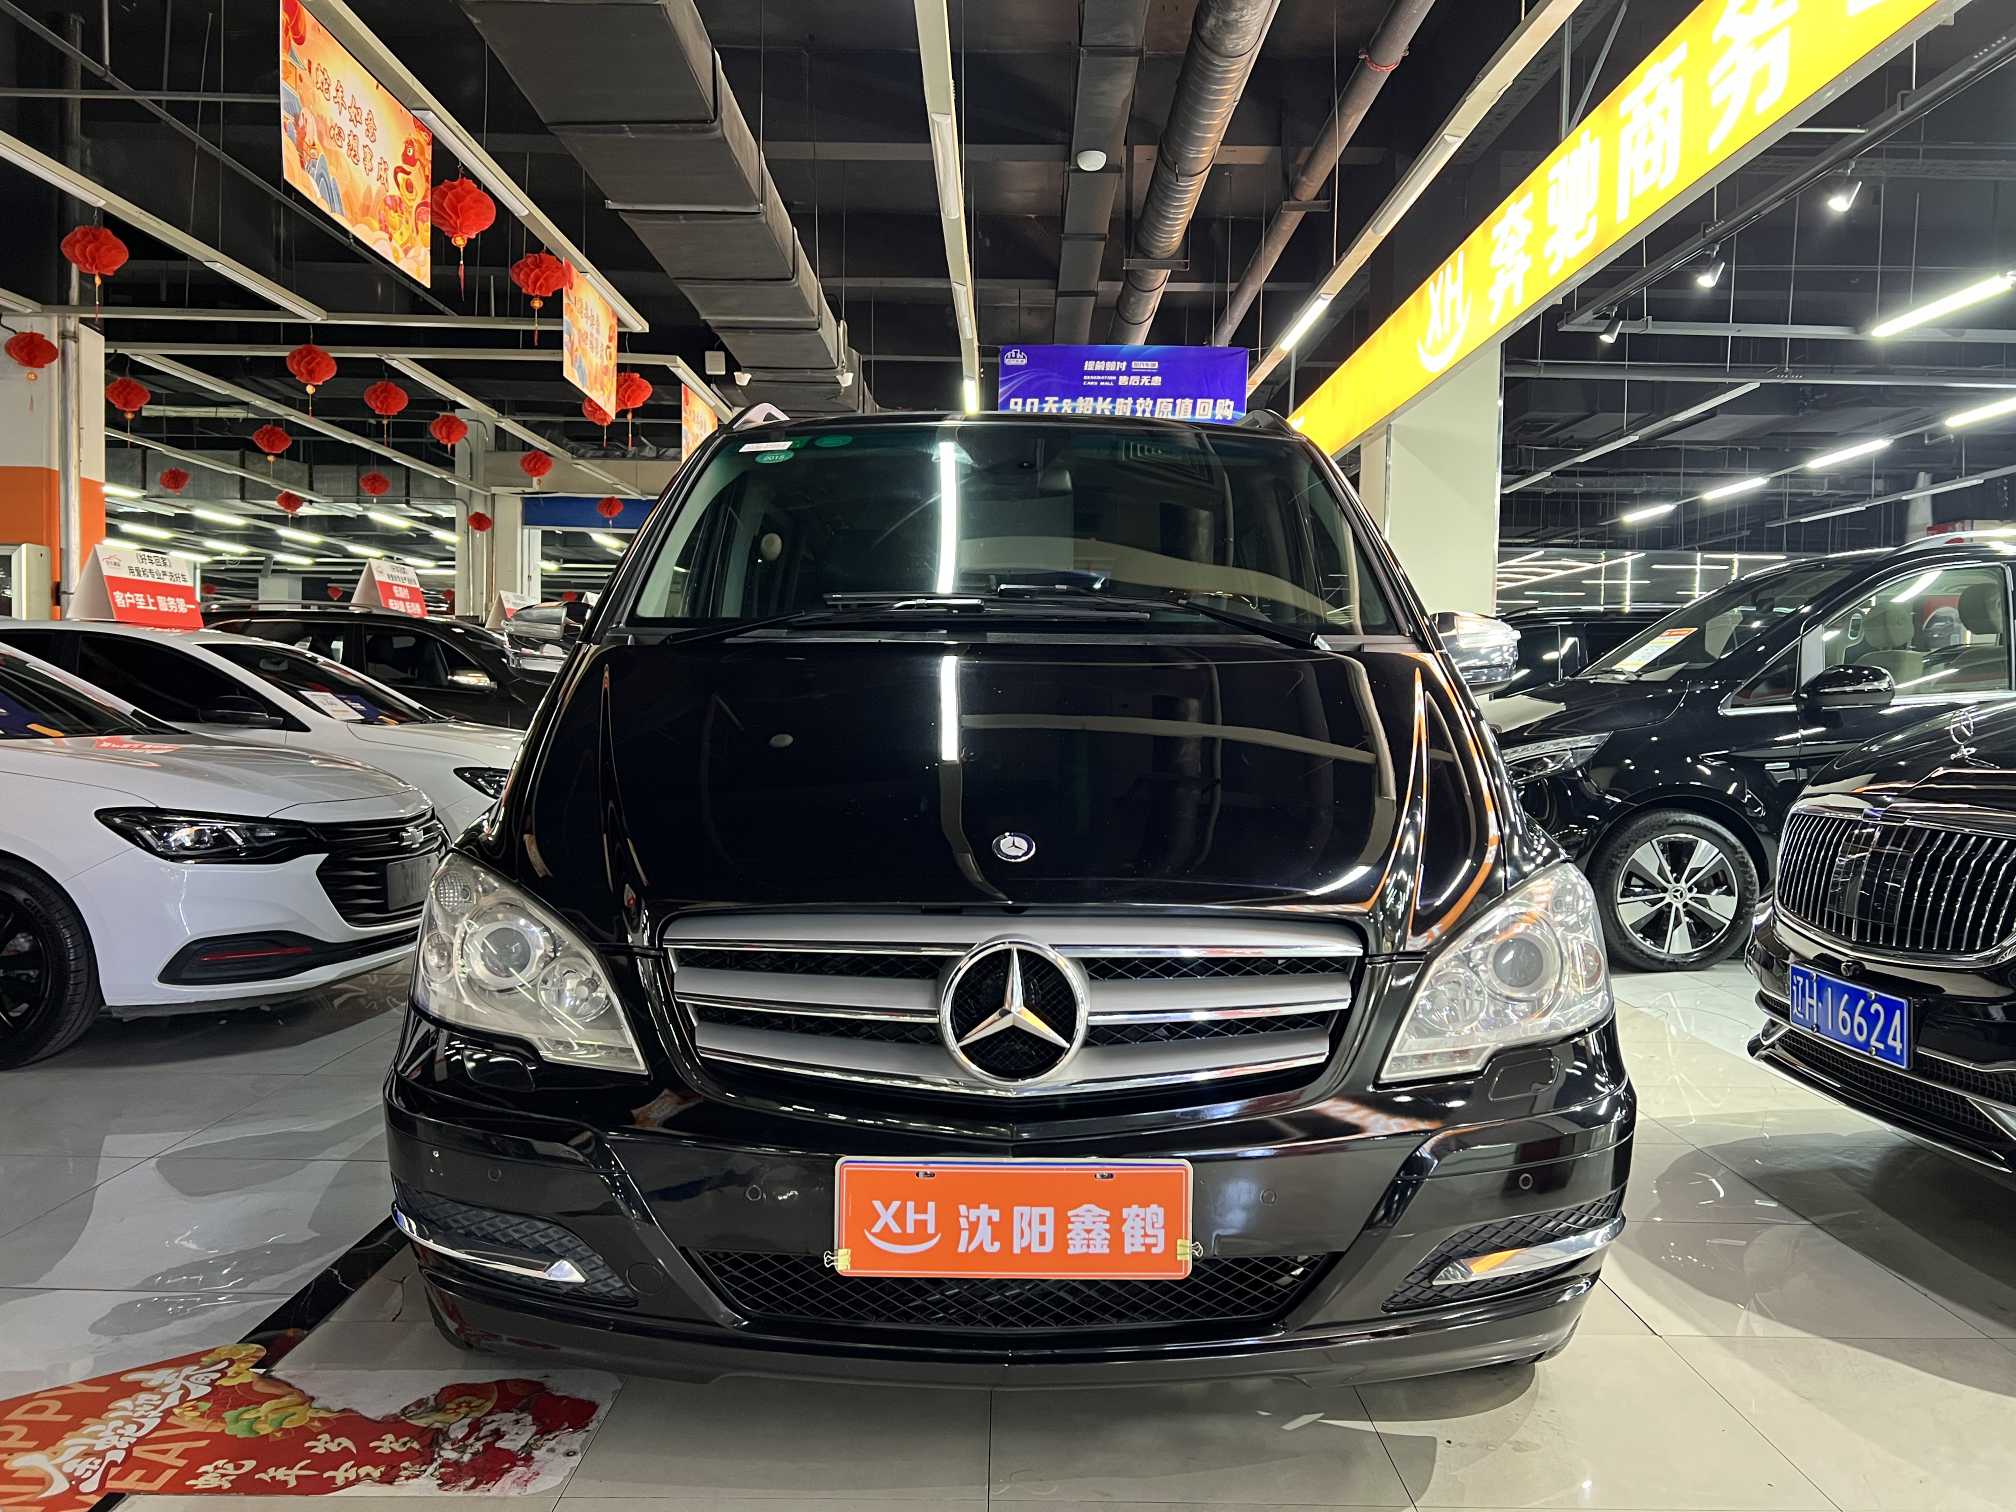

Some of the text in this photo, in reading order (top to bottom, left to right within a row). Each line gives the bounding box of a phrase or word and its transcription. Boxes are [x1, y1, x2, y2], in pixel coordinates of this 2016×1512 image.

[315, 63, 377, 143] 蛇年如意
[329, 123, 389, 193] 心想事成
[1489, 0, 1882, 325] 奔驰商务
[113, 590, 196, 614] 客户至上 服务第一
[870, 1200, 1165, 1254] XH 沈阳鑫鹤
